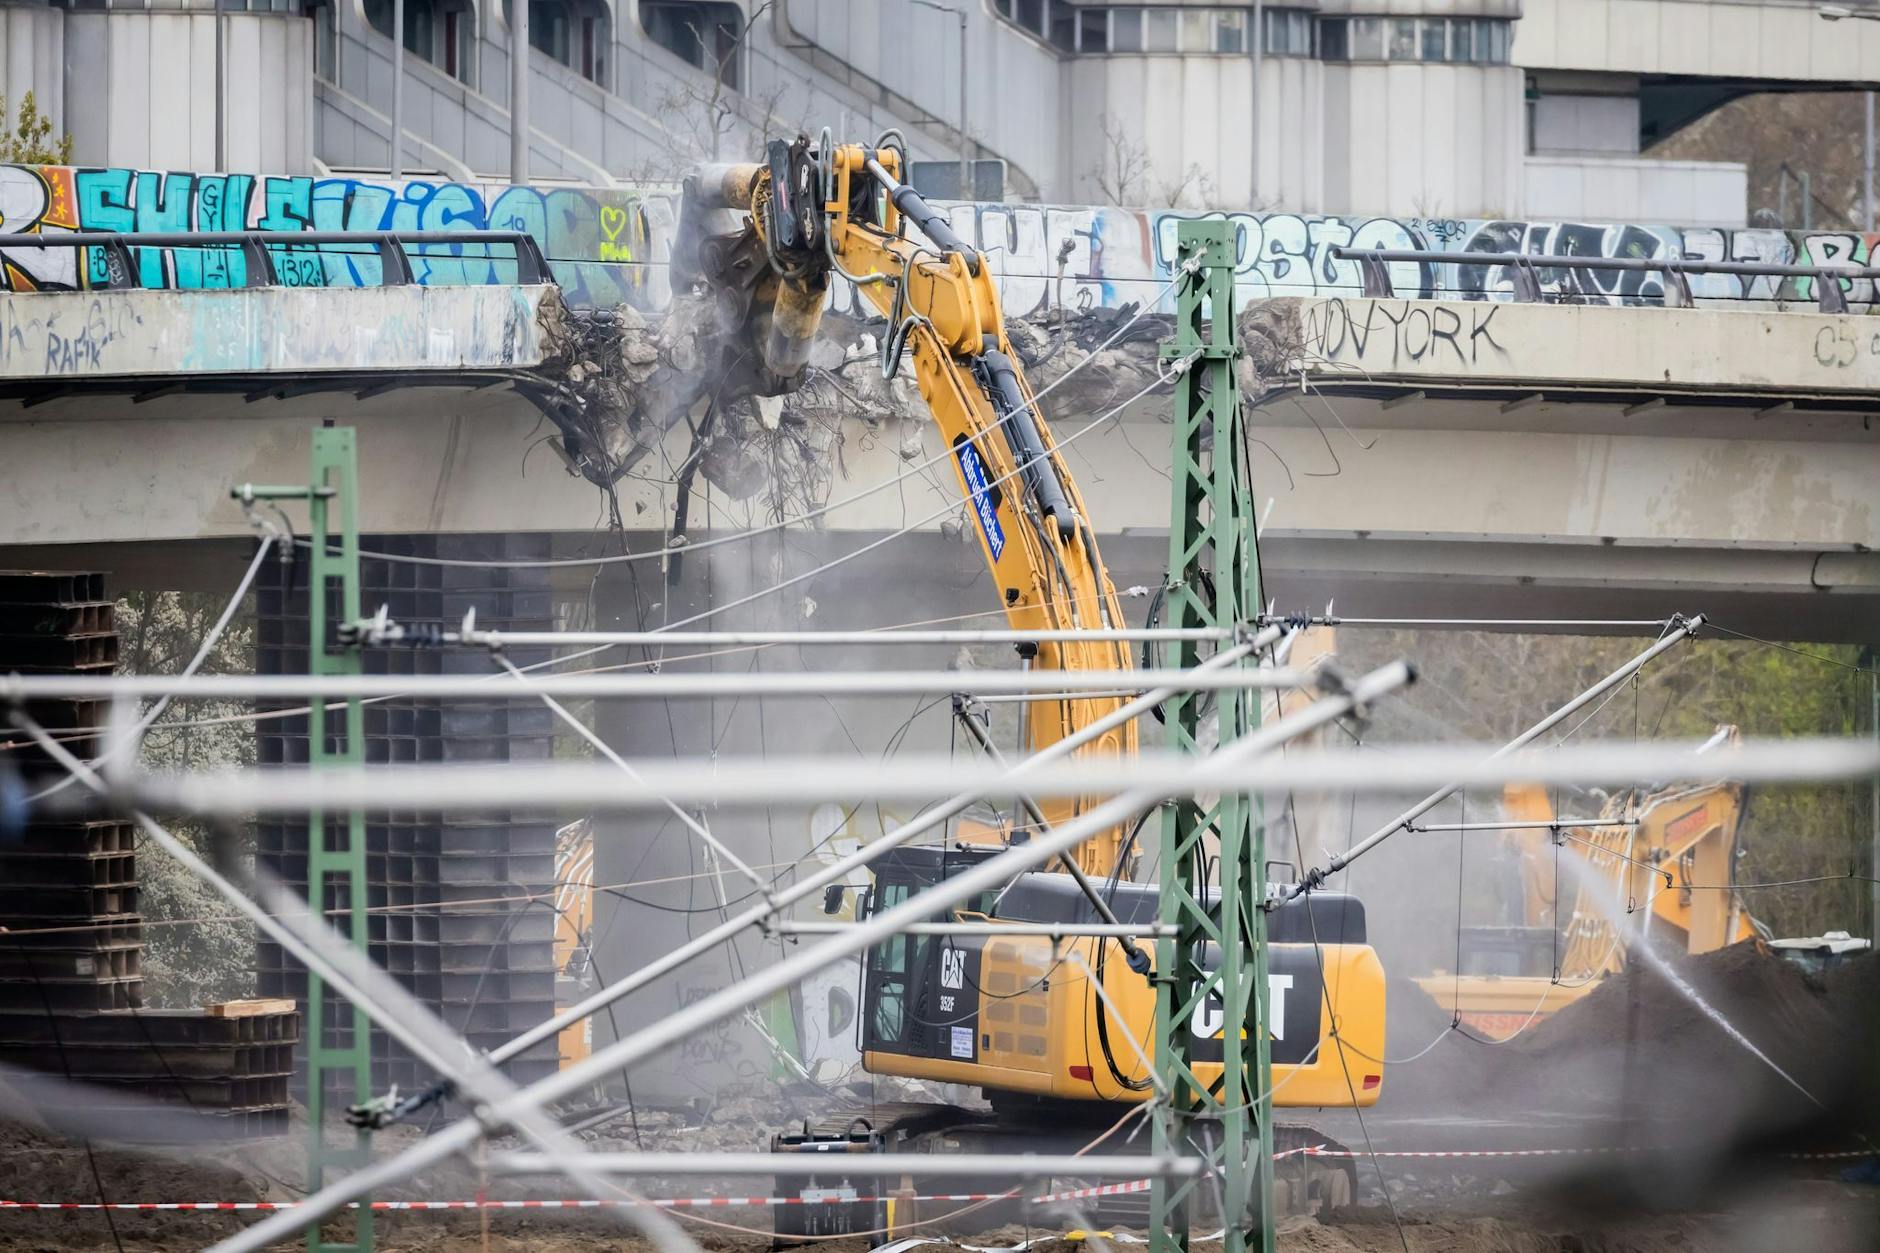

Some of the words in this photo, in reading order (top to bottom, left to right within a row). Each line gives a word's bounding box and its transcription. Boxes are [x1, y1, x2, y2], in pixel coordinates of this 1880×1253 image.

[980, 497, 1003, 559] Büchert
[941, 948, 967, 990] CAT
[1190, 971, 1294, 1041] CT
